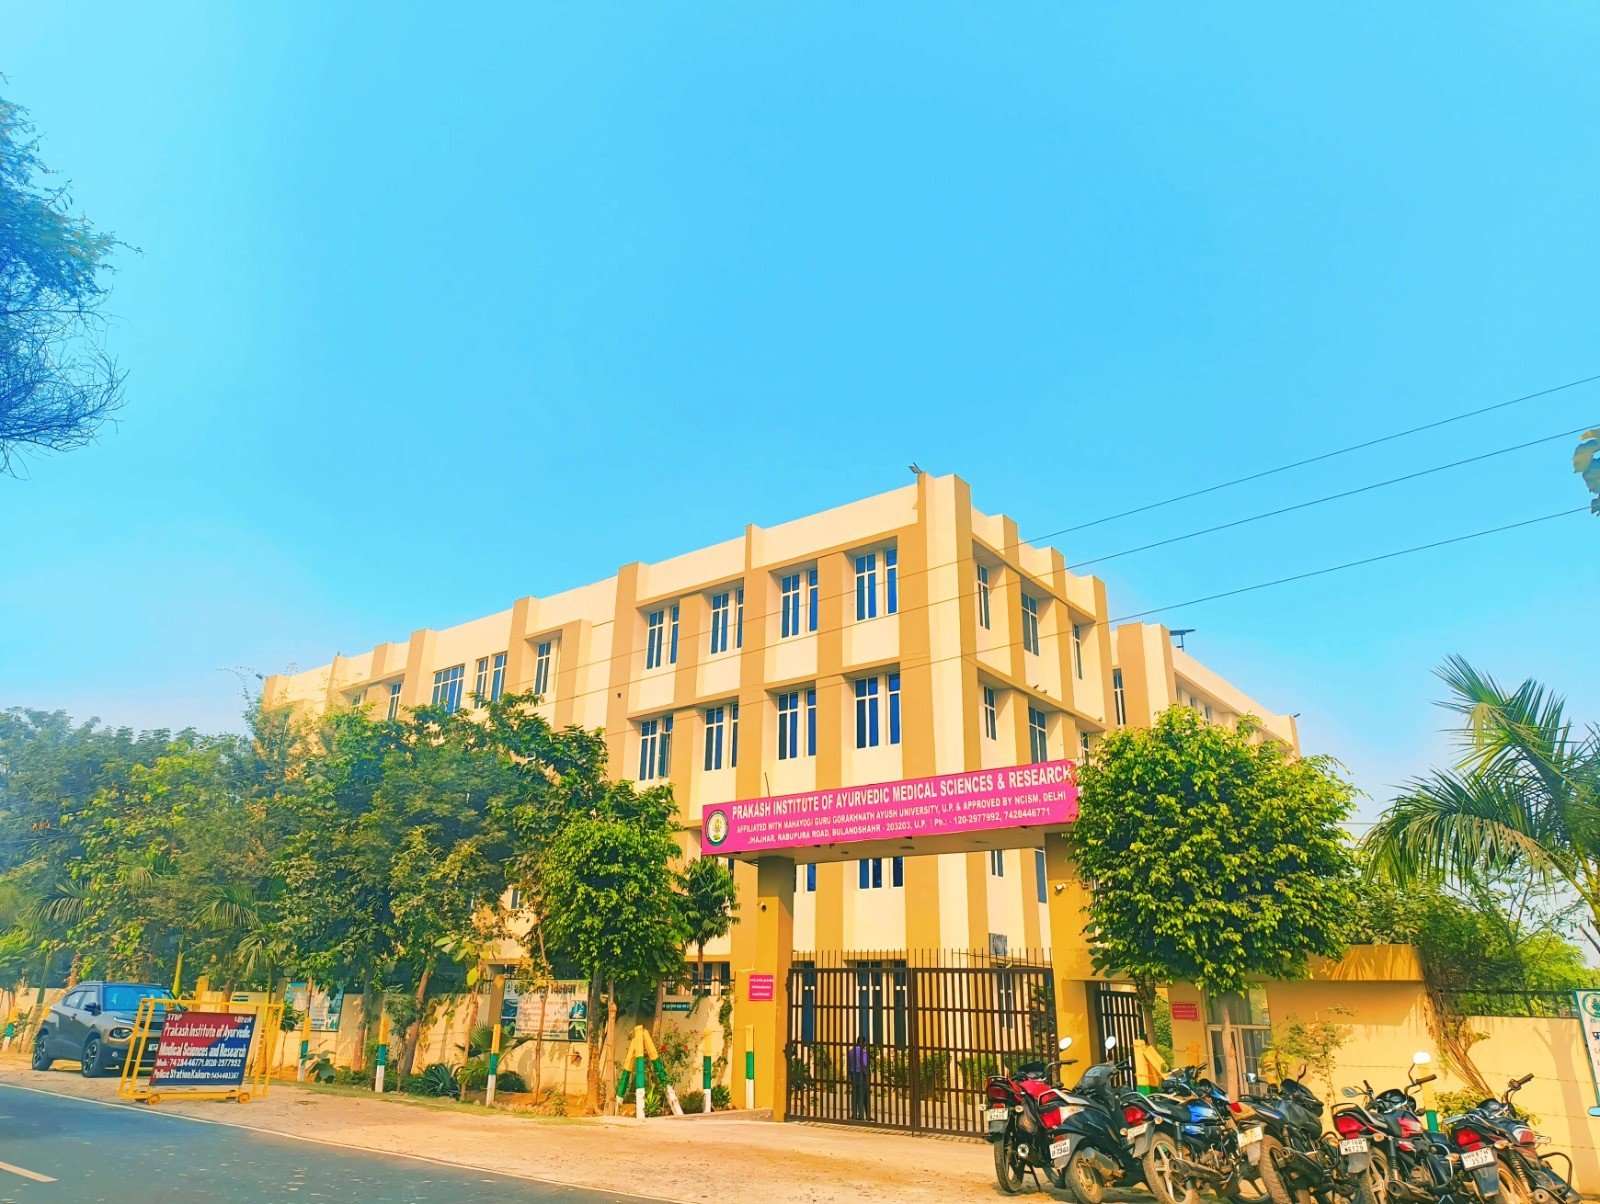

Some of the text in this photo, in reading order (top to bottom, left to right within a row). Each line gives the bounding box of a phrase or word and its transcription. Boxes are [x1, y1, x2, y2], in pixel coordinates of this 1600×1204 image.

[732, 765, 1072, 820] PRAKASH INSTITUTE OF AYURVEDIC MEDICAL SCIENCES & RESEARCH
[737, 822, 766, 834] AFFILIATED
[768, 821, 782, 830] WITH
[784, 818, 813, 829] MAHAYOGI
[815, 816, 831, 826] GURU
[833, 811, 875, 824] GORAKHNATH
[876, 809, 898, 820] AYUSH
[955, 802, 961, 811] &
[963, 798, 1000, 811] APPROVED
[1002, 796, 1012, 806] BY
[1043, 790, 1066, 802] DELHI
[778, 831, 810, 841] RABUPURA
[832, 824, 880, 836] BULANDSHAHR
[163, 1022, 189, 1037] Prakash
[189, 1023, 216, 1038] Institute
[216, 1024, 225, 1037] of
[158, 1042, 183, 1056] Medical
[182, 1042, 209, 1057] Sciences
[209, 1043, 220, 1057] and
[219, 1043, 246, 1057] Research
